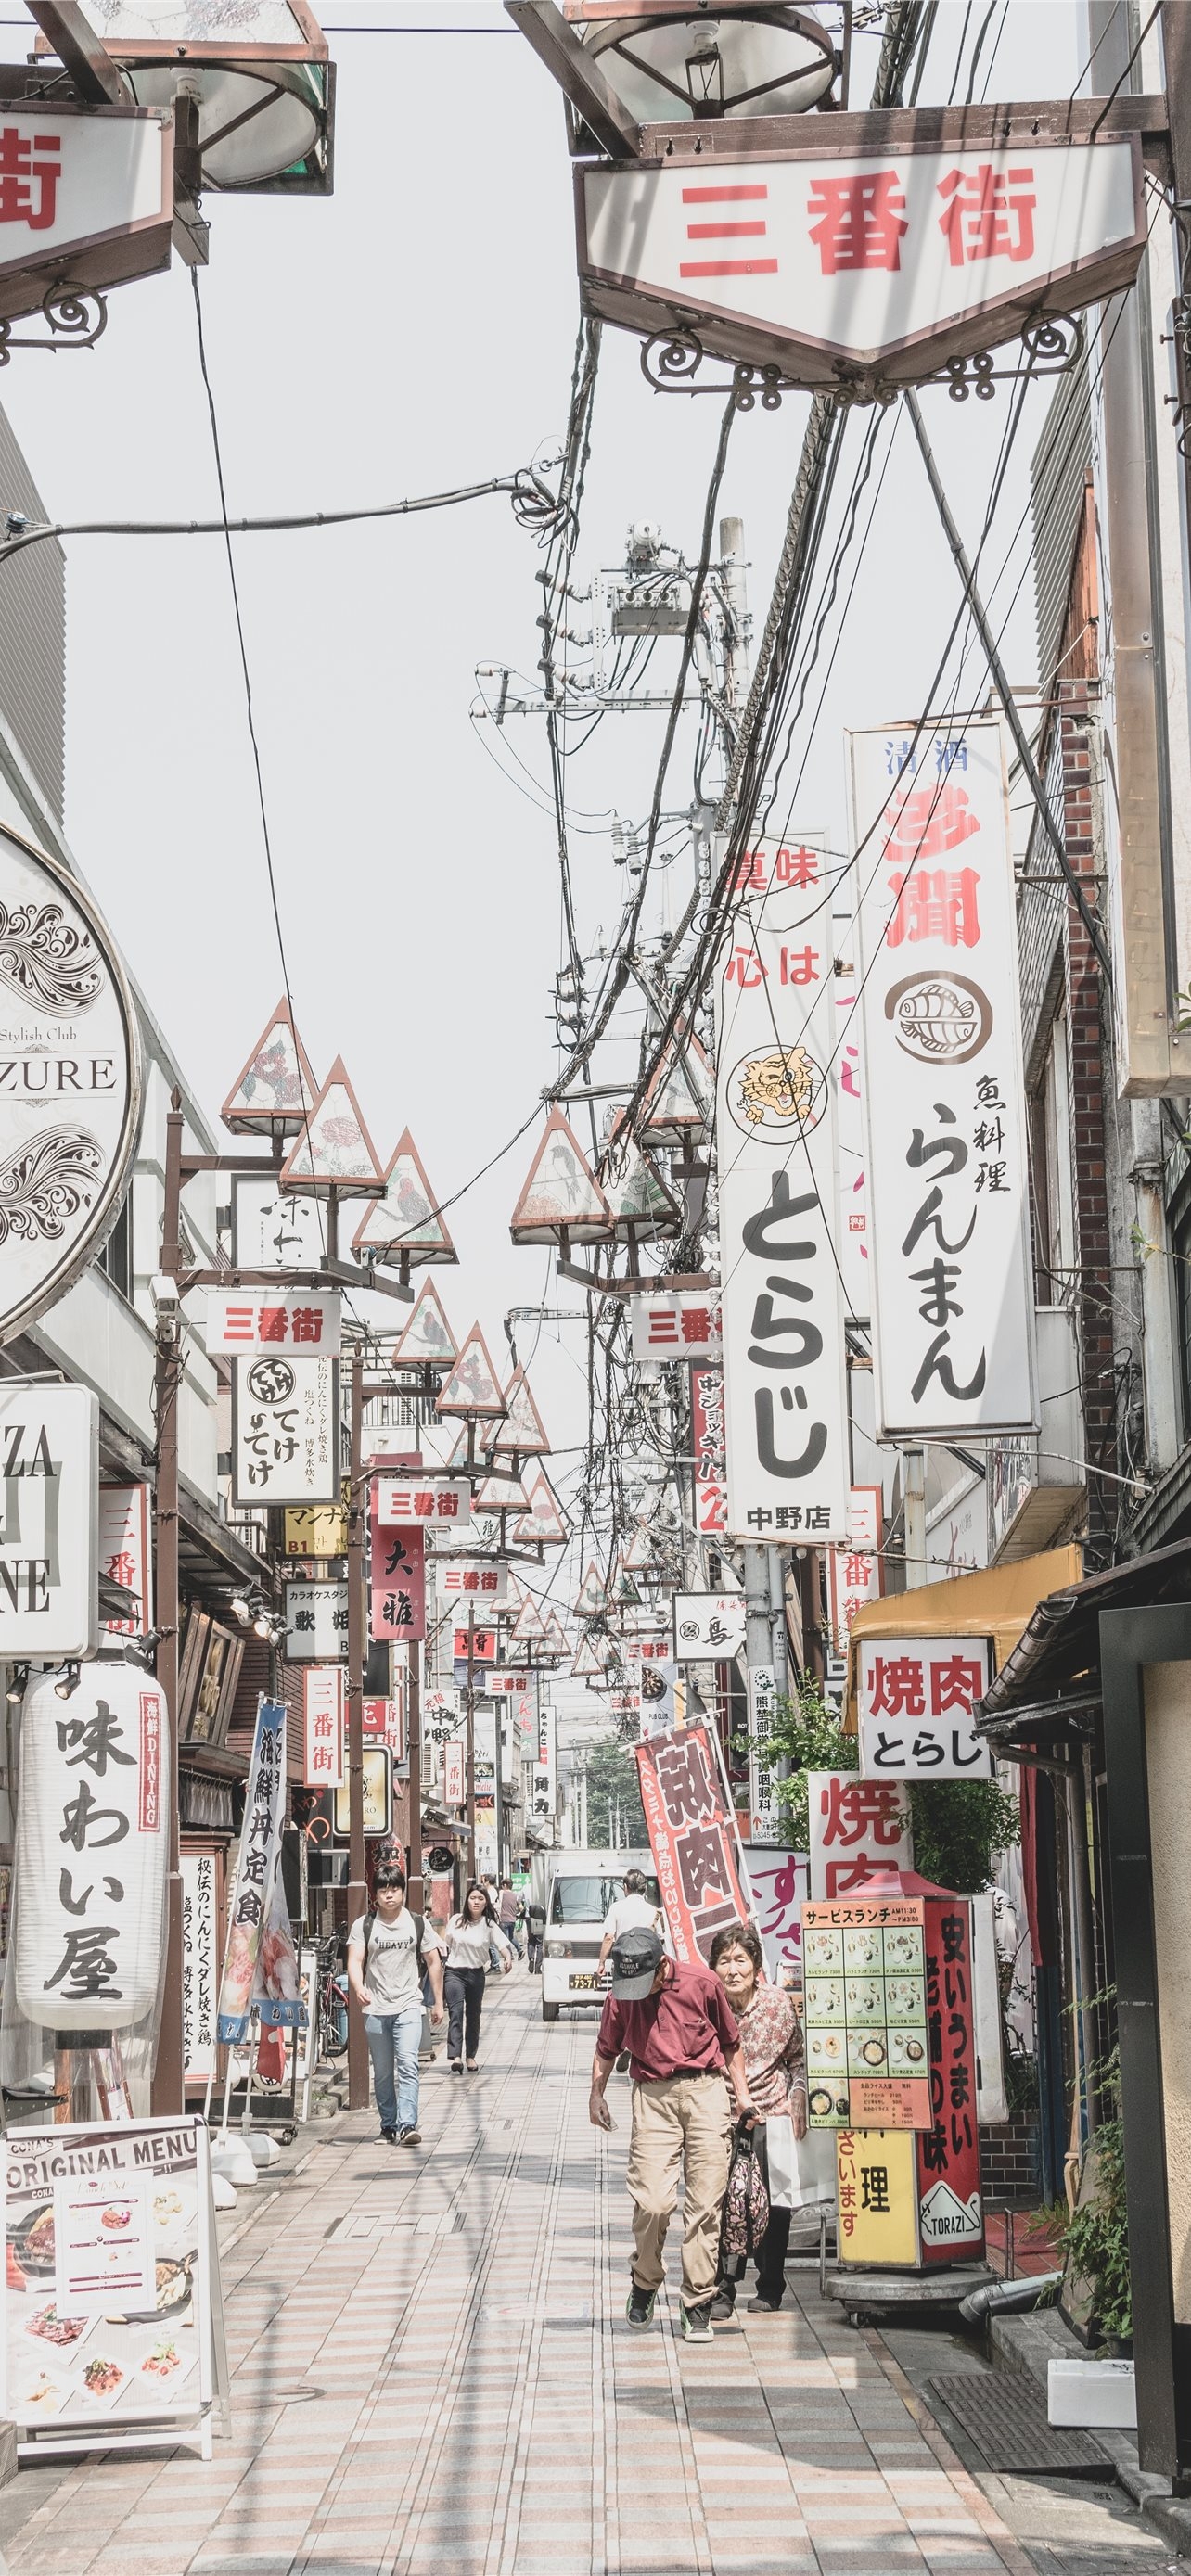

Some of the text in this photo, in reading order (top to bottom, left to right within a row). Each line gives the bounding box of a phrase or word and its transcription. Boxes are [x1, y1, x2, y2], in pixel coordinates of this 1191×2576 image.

[0, 127, 62, 230] 街
[679, 164, 1037, 279] 三番街
[883, 738, 969, 776] 清酒
[0, 1026, 77, 1044] Stylish Club
[972, 1074, 1013, 1195] 魚料理
[901, 1102, 987, 1404] らんまん
[223, 1307, 324, 1343] 三番街
[741, 1169, 828, 1480] とらじ
[390, 1491, 459, 1517] 三番街
[747, 1504, 832, 1531] 中野店
[288, 1539, 308, 1553] B1
[382, 1539, 415, 1626] 大雅
[444, 1571, 498, 1591] 三番街
[628, 1642, 669, 1658] 三番街
[492, 1677, 527, 1691] 三番街
[866, 1654, 983, 1717] 焼肉
[312, 1681, 335, 1771] 三番街
[873, 1729, 984, 1767] とらじ
[146, 1737, 157, 1825] DINING
[449, 1749, 460, 1797] 三番街
[43, 1699, 138, 2000] 味わい屋
[235, 1727, 275, 1928] 海鮮丼定食
[805, 1907, 891, 1925] サービスランチ
[197, 1857, 212, 2047] 秘伝のにんにくダレ焼き鶏
[378, 1940, 410, 1950] HEAVY
[941, 1913, 973, 2157] 安いうまい
[6, 2129, 198, 2189] ORIGINAL MENU
[930, 2214, 966, 2236] TORAZI
